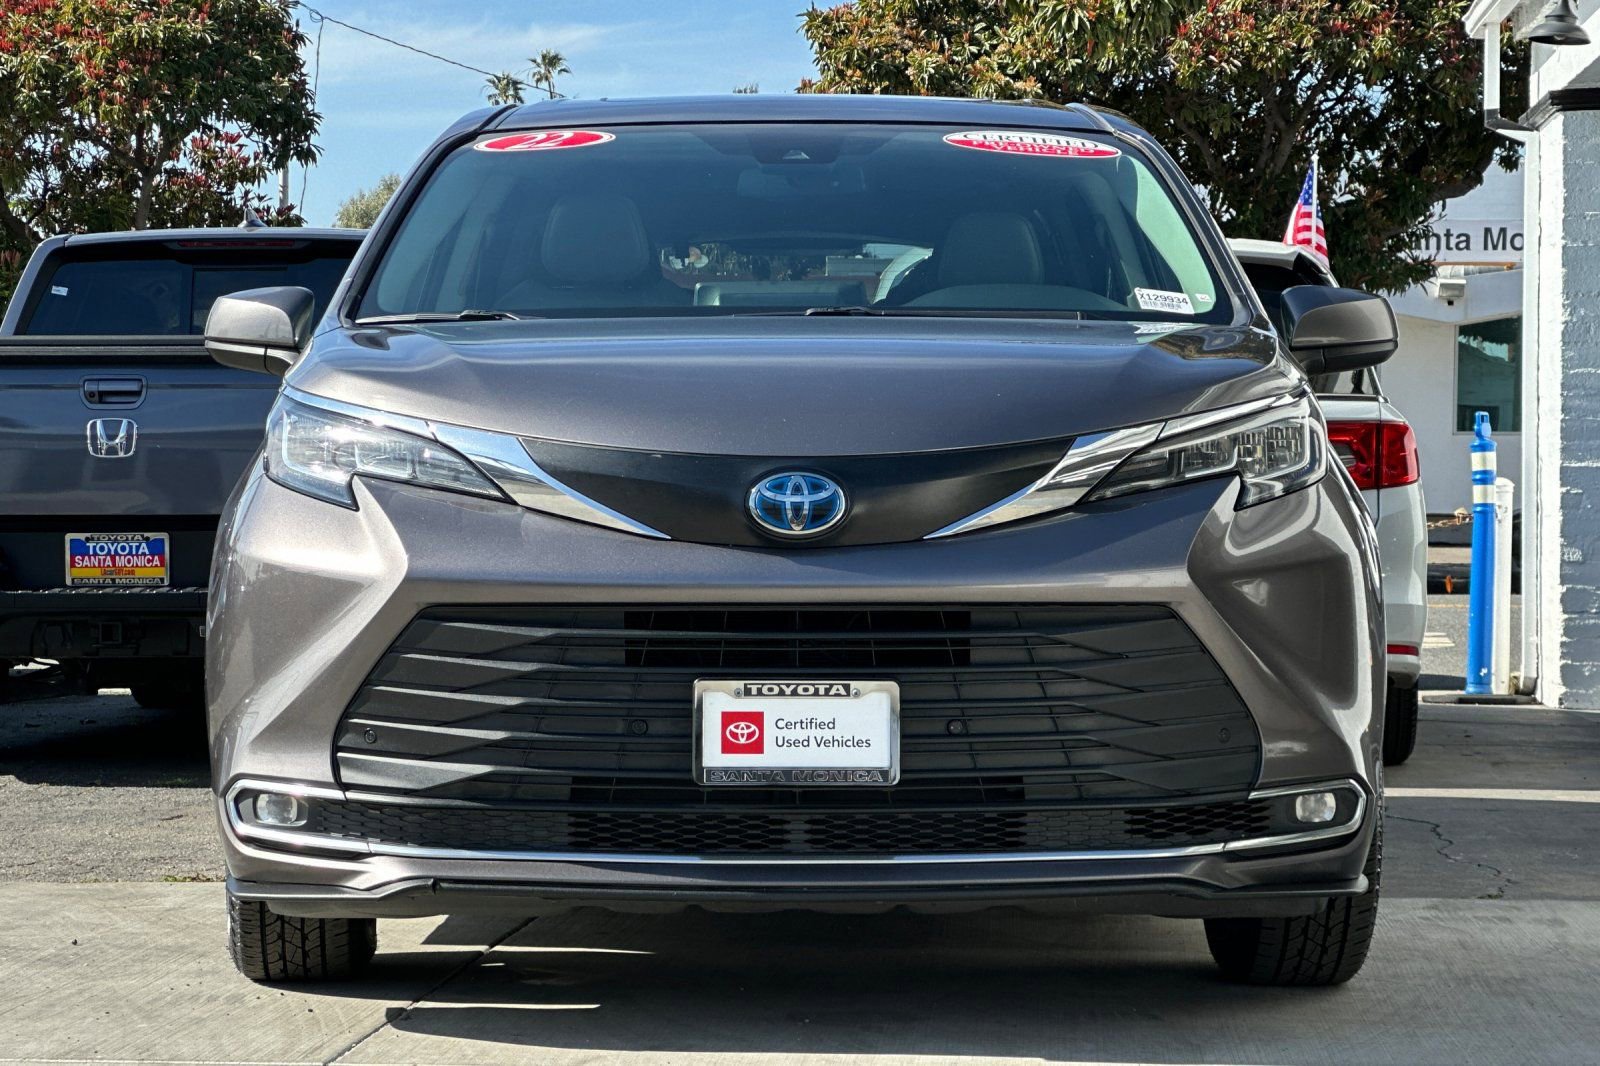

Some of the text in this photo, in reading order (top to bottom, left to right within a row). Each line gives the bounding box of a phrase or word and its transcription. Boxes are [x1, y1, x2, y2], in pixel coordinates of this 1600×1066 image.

[503, 131, 575, 150] 22
[963, 133, 1099, 148] CERTIFIED
[1413, 228, 1472, 251] nta
[1138, 292, 1189, 305] X129934
[86, 542, 149, 555] TOYOTA
[75, 556, 160, 567] SANTA MONICA
[747, 684, 847, 695] TOYOTA
[775, 717, 836, 730] Certified
[775, 735, 871, 748] Used Vehicles
[710, 769, 883, 782] SANTA MONICA
